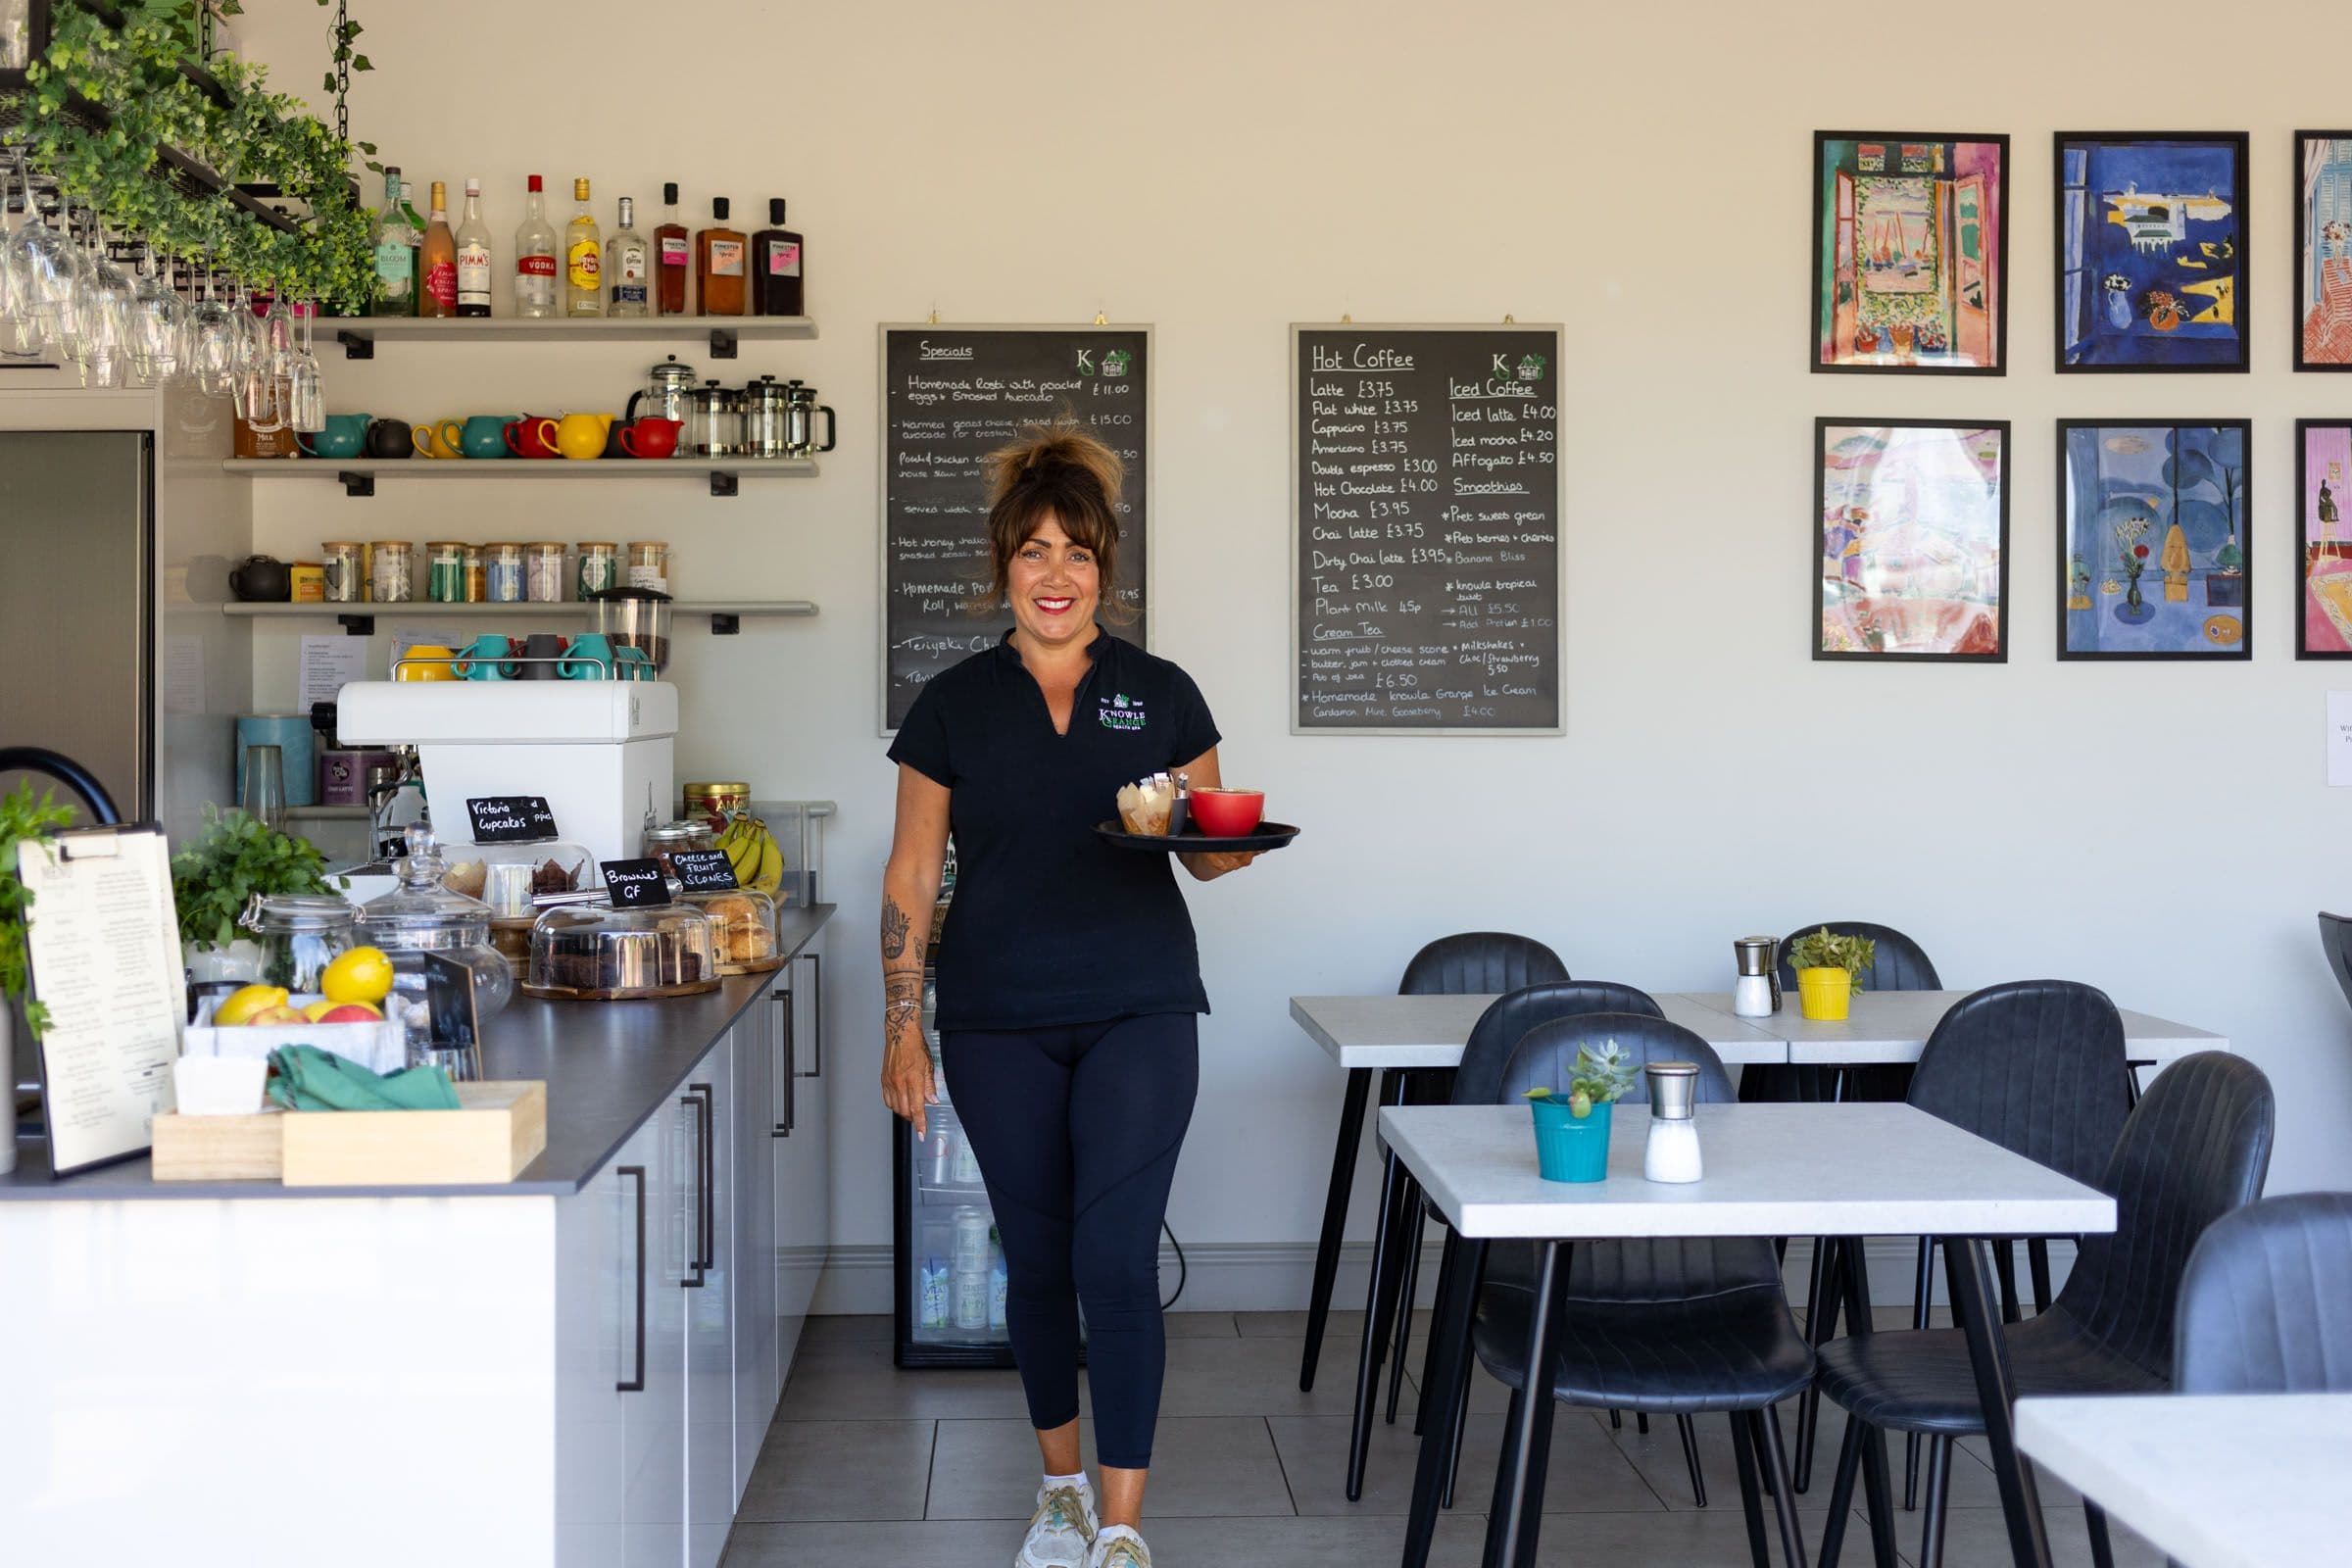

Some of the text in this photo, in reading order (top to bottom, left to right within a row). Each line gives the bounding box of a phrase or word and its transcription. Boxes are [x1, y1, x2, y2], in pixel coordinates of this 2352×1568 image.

[460, 253, 490, 268] PIMM'S
[528, 262, 555, 270] VODKA
[919, 340, 973, 359] Specials
[1312, 343, 1414, 369] Hot Coffee
[1076, 350, 1093, 368] K
[1492, 353, 1510, 372] K
[907, 374, 971, 390] Homemade
[1009, 379, 1036, 390] with
[1310, 377, 1394, 398] Latte £3.75
[1450, 376, 1535, 397] Iced Coffee
[907, 392, 1054, 406] eggs Smashed Avocado
[1312, 400, 1418, 416] Flat white £3.75
[1451, 403, 1556, 422] Iced latte £4.00
[1091, 414, 1132, 425] £15.00
[1374, 419, 1408, 434] £3.75
[1451, 426, 1553, 448] Iced mocha £4.20
[1311, 438, 1408, 455] Americano £3.75
[1311, 459, 1438, 477] Double espresso £3.00
[1451, 451, 1554, 472] Affogato £4.50
[963, 468, 980, 477] and
[1313, 477, 1438, 497] Hot Chocolate £4.00
[1453, 477, 1524, 493] Smoothies
[904, 505, 938, 514] served
[1313, 501, 1410, 520] Mocha £3.95
[1514, 512, 1545, 526] green
[1312, 522, 1425, 541] Chai latte £3.75
[1476, 533, 1510, 543] berries
[1520, 531, 1554, 543] cherries
[899, 536, 918, 548] Hot
[1312, 548, 1446, 571] Dirty Chai latte £3.95
[1454, 550, 1526, 564] Banana Bliss
[903, 582, 965, 598] Homemade
[1311, 573, 1394, 594] Tea £3.00
[1495, 578, 1538, 591] tropical
[922, 598, 951, 617] Roll,
[1315, 598, 1351, 616] Plant
[1398, 600, 1422, 614] 45p
[1458, 603, 1521, 617] All £5.50
[1312, 621, 1384, 640] Cream Tea
[1458, 620, 1479, 630] Add
[1520, 617, 1553, 628] £1.00
[902, 636, 964, 660] Teriyaki
[1310, 647, 1342, 657] warm
[1418, 646, 1449, 655] scone
[1461, 640, 1514, 652] Milkshakes
[1348, 660, 1369, 670] jam
[1380, 659, 1414, 667] clotted
[1418, 658, 1446, 666] cream
[1331, 672, 1342, 684] of
[1375, 672, 1418, 689] £6.50
[1311, 690, 1378, 705] Homemade
[1435, 688, 1475, 702] Grange
[1482, 683, 1499, 697] Ice
[1501, 683, 1538, 697] Cream
[1098, 709, 1146, 721] KNOWLE
[1462, 705, 1496, 717] £4.00
[1102, 716, 1147, 728] GRANGE
[472, 801, 511, 815] Victoria
[478, 815, 527, 832] Cupcakes
[674, 850, 725, 865] Cheese and
[686, 861, 718, 873] FRUIT
[606, 868, 659, 884] Brownies
[685, 871, 734, 886] SCONES
[623, 884, 642, 900] GF
